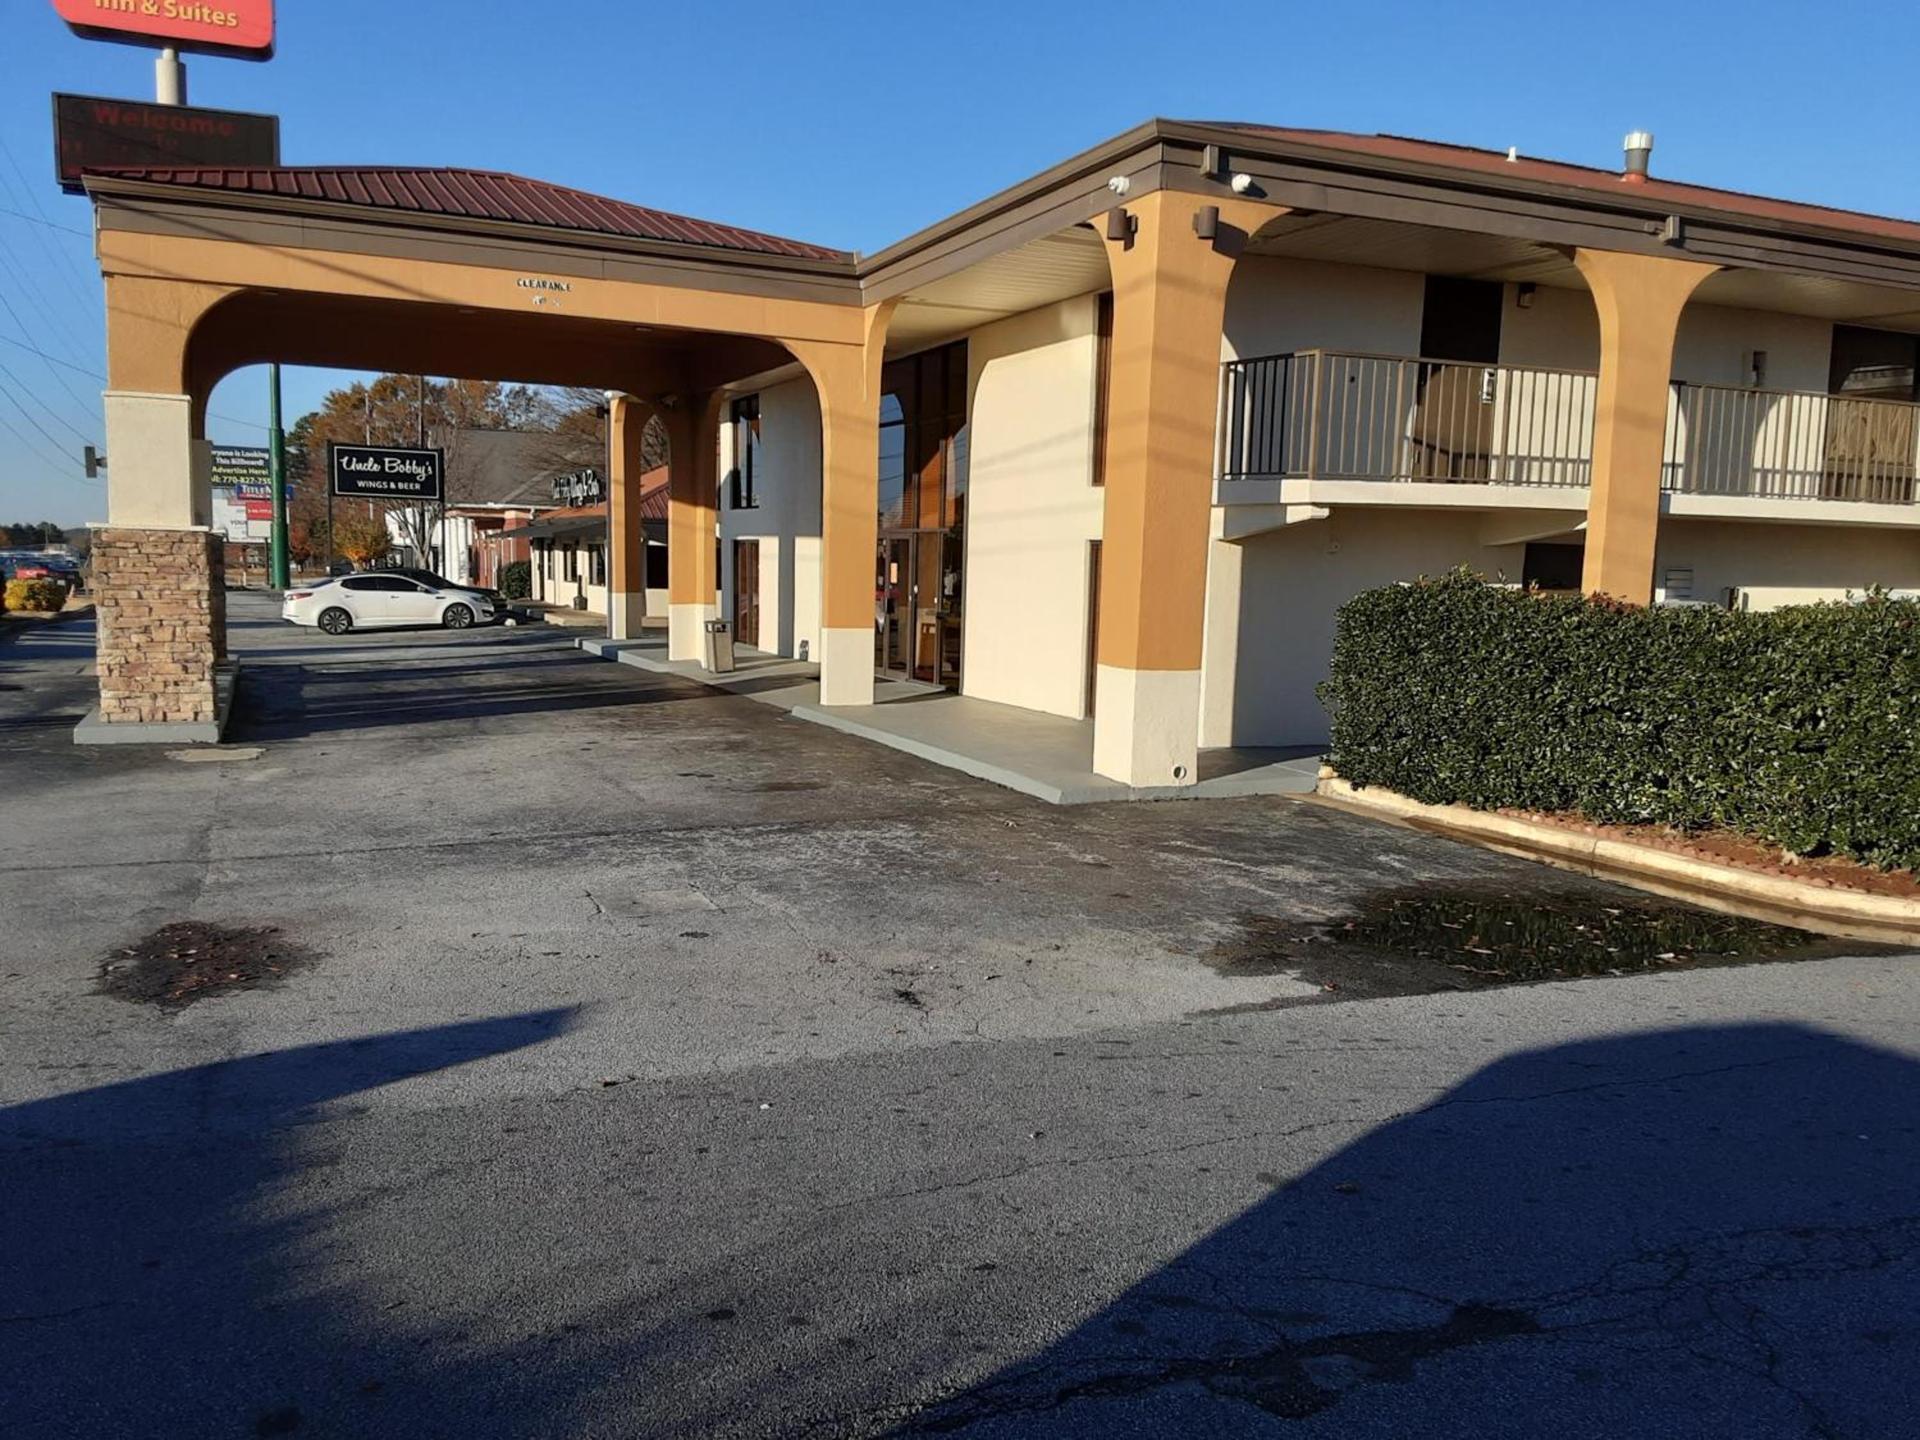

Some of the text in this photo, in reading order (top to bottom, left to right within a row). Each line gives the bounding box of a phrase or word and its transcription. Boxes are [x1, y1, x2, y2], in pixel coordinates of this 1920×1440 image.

[141, 0, 160, 16] &
[164, 0, 238, 27] Suites
[95, 106, 235, 137] Welcome
[516, 278, 572, 292] CLEARANCE
[211, 466, 247, 475] Advertise
[339, 456, 433, 482] Uncle Bobby's
[356, 480, 421, 490] WINGS & BEER
